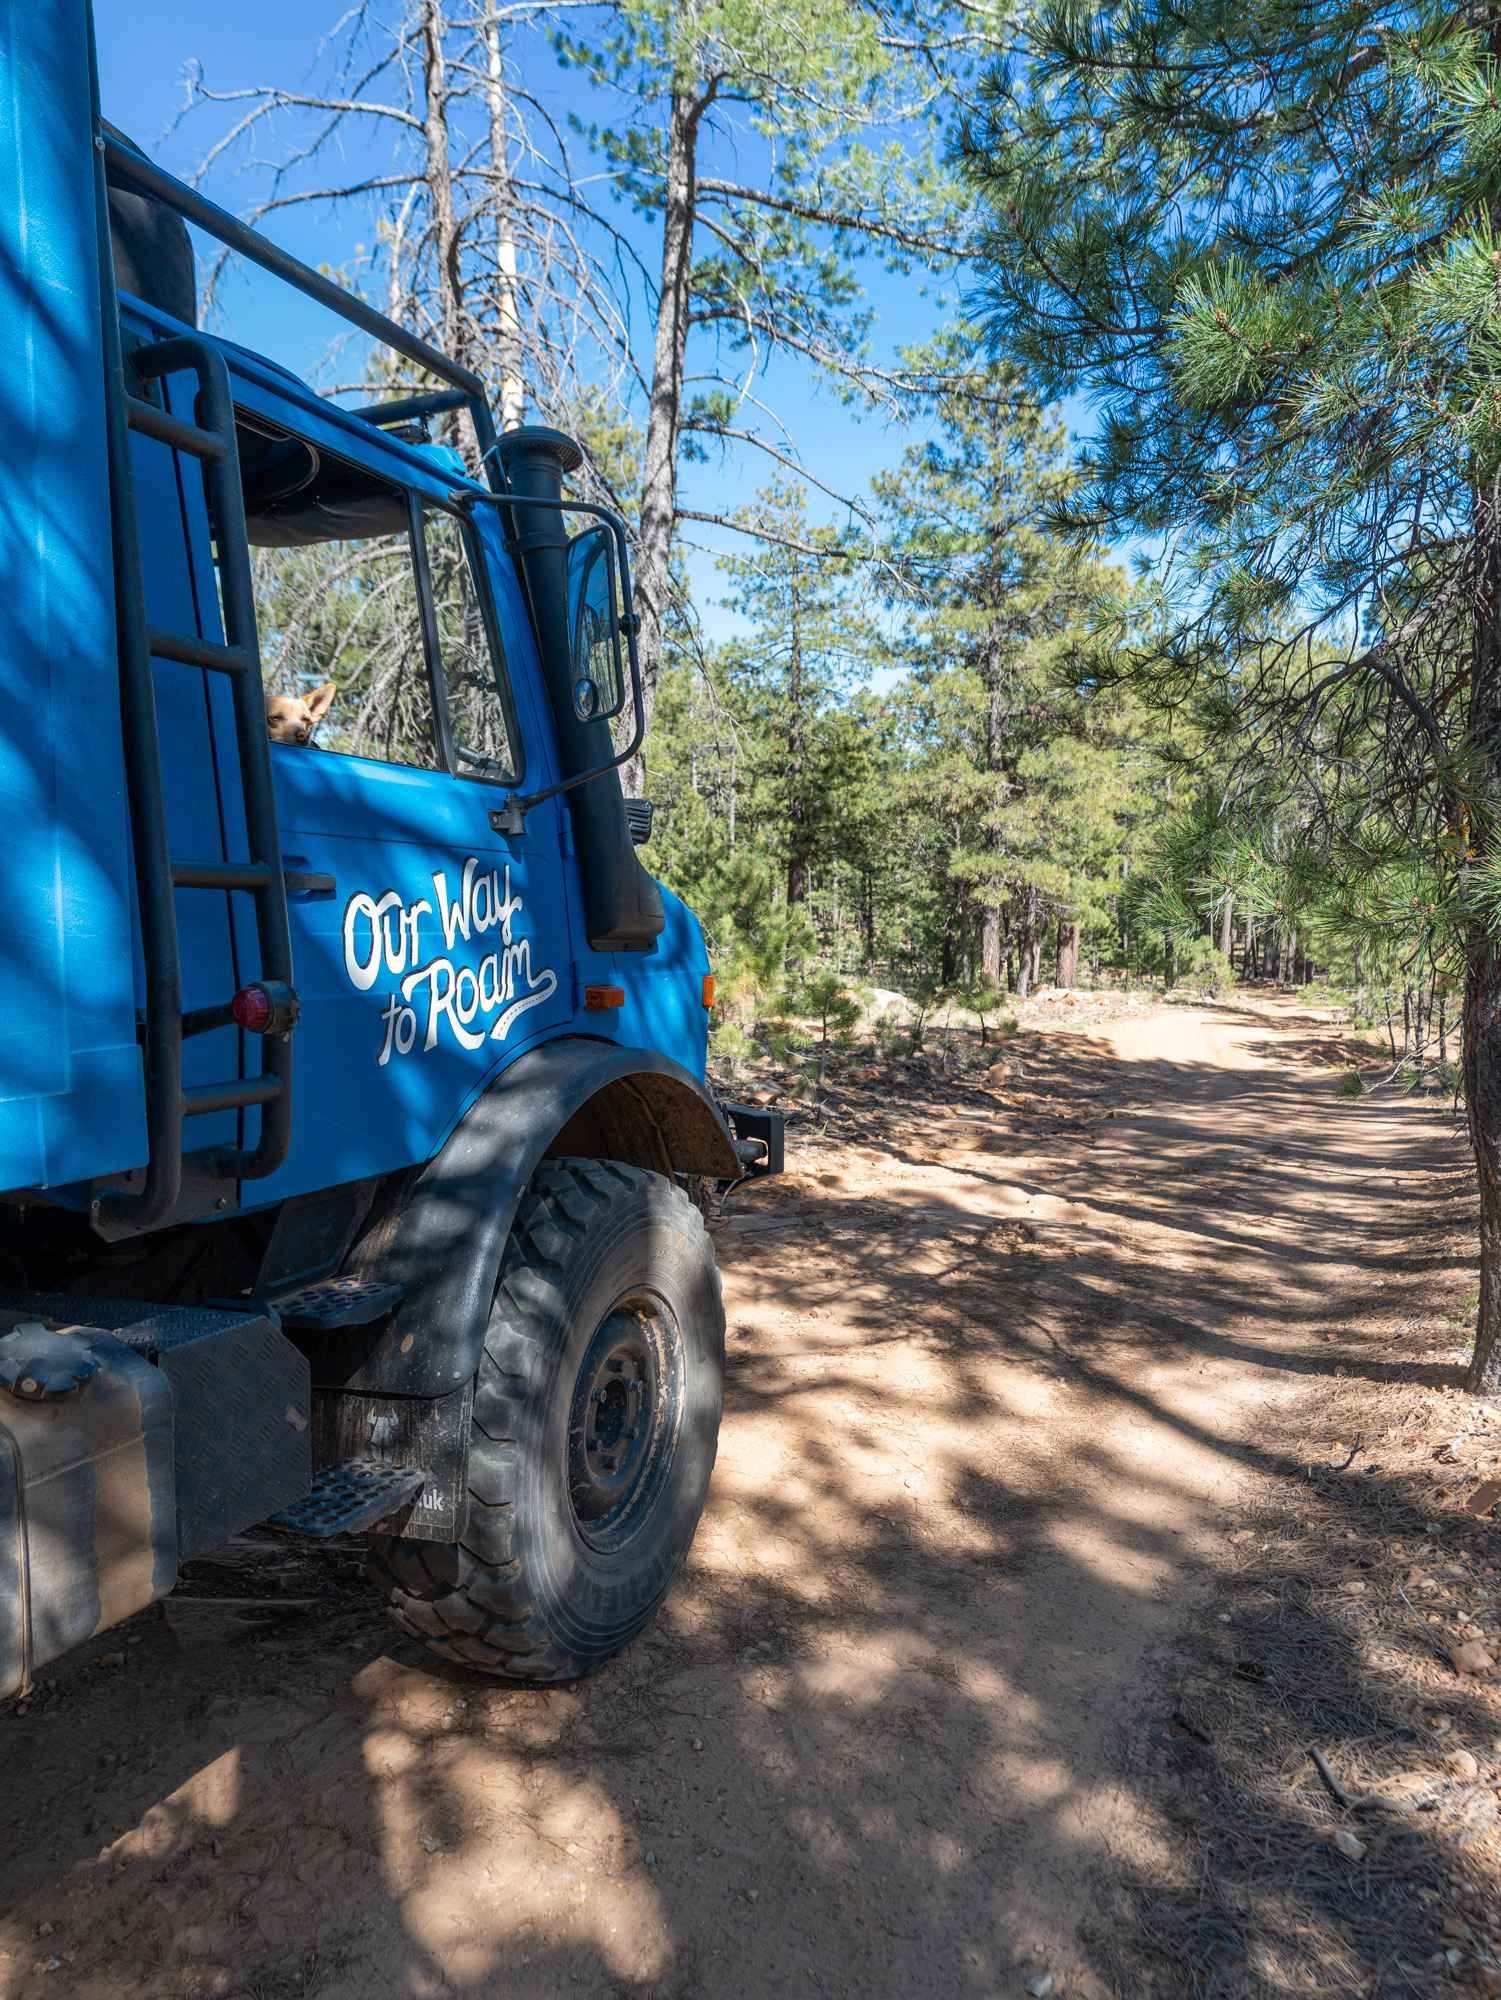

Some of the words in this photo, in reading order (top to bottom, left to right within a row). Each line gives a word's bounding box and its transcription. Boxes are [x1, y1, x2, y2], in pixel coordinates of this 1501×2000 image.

[344, 891, 432, 991] Our
[432, 857, 523, 950] Way
[378, 994, 416, 1066] to
[401, 939, 558, 1052] Roam
